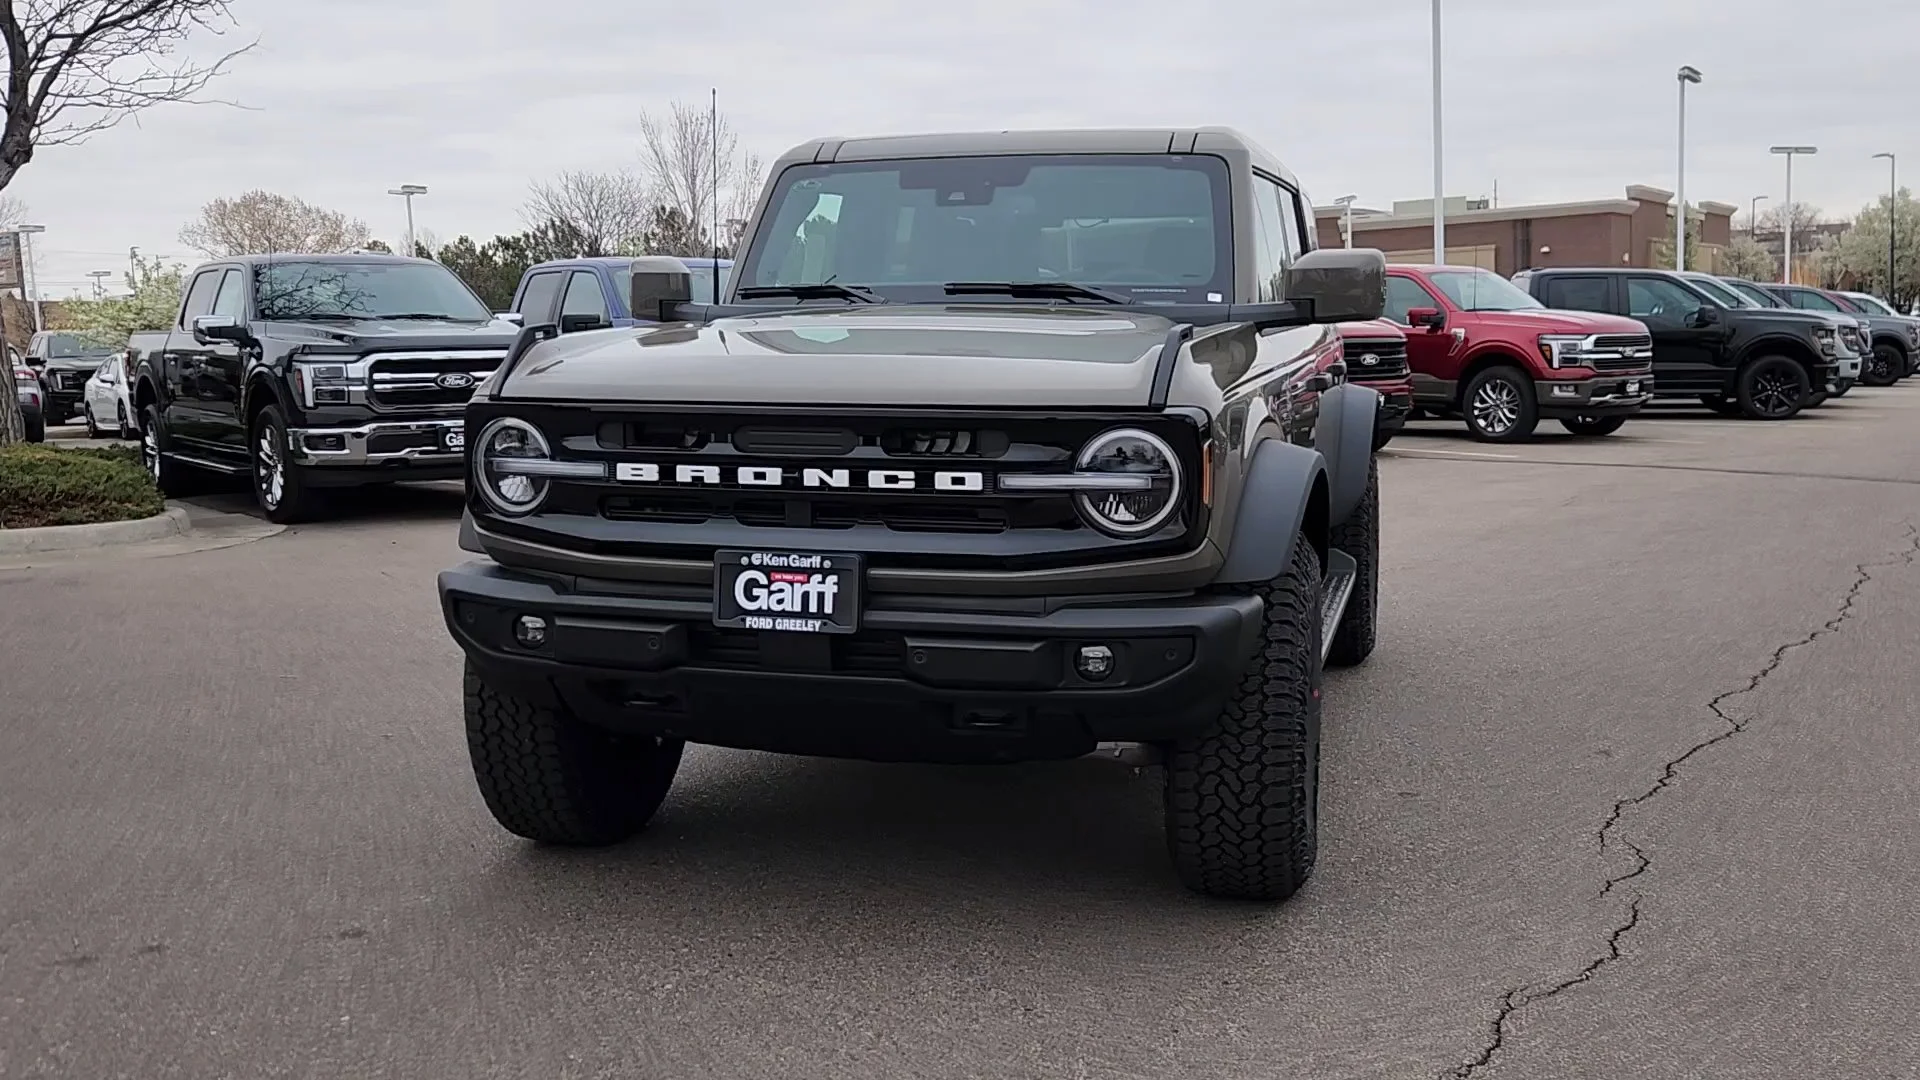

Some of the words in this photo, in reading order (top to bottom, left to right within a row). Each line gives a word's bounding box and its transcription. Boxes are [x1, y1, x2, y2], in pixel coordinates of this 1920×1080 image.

[444, 375, 466, 385] Ford
[445, 433, 464, 446] Ga
[616, 463, 983, 490] BRONCO
[763, 553, 788, 567] Ken
[789, 554, 821, 568] Garff
[734, 570, 838, 614] Garff
[746, 617, 773, 630] FORD
[775, 618, 821, 632] GREELEY
